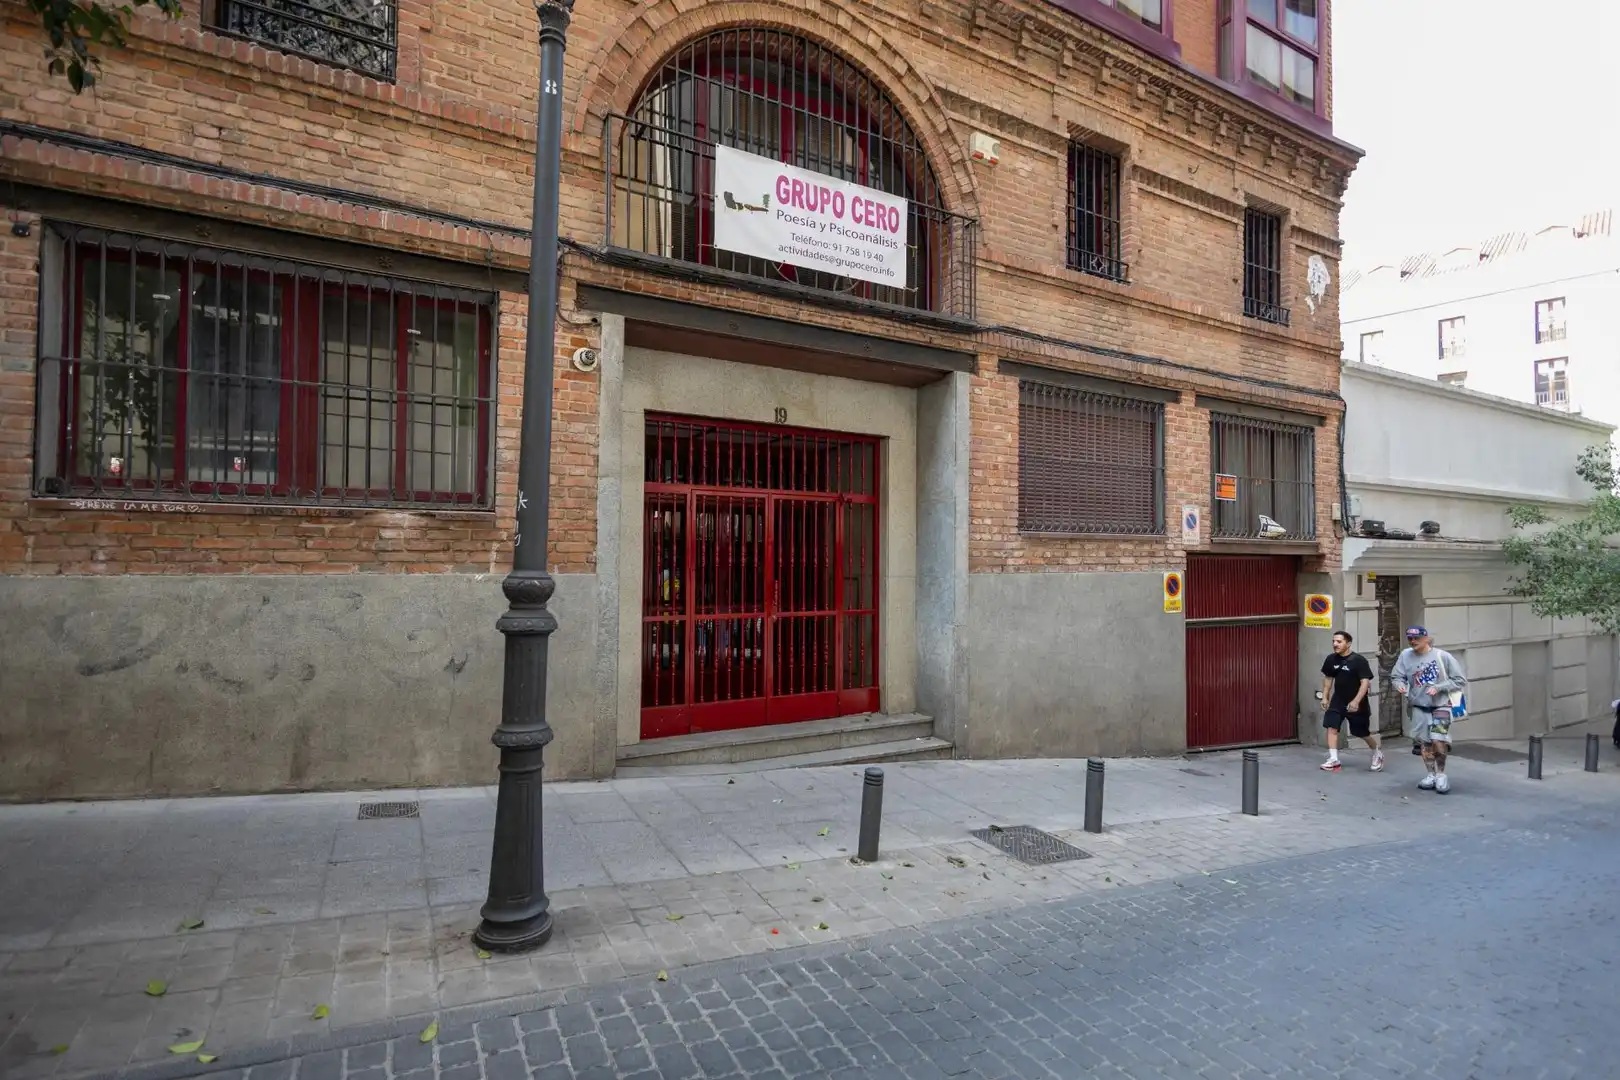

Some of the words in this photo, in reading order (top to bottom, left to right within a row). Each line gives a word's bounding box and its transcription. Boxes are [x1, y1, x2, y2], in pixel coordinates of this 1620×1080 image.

[775, 175, 846, 219] GRUPO
[851, 195, 900, 234] CERO
[776, 209, 816, 229] Poesía
[819, 222, 827, 233] y
[829, 222, 899, 250] Psicoanálisis
[778, 244, 895, 277] actividades@grupocero.info
[790, 232, 831, 250] Teléfono:
[832, 243, 842, 252] 91
[845, 245, 860, 257] 758
[862, 249, 872, 260] 19
[872, 253, 884, 263] 40
[774, 407, 788, 424] 19
[123, 502, 137, 511] LA
